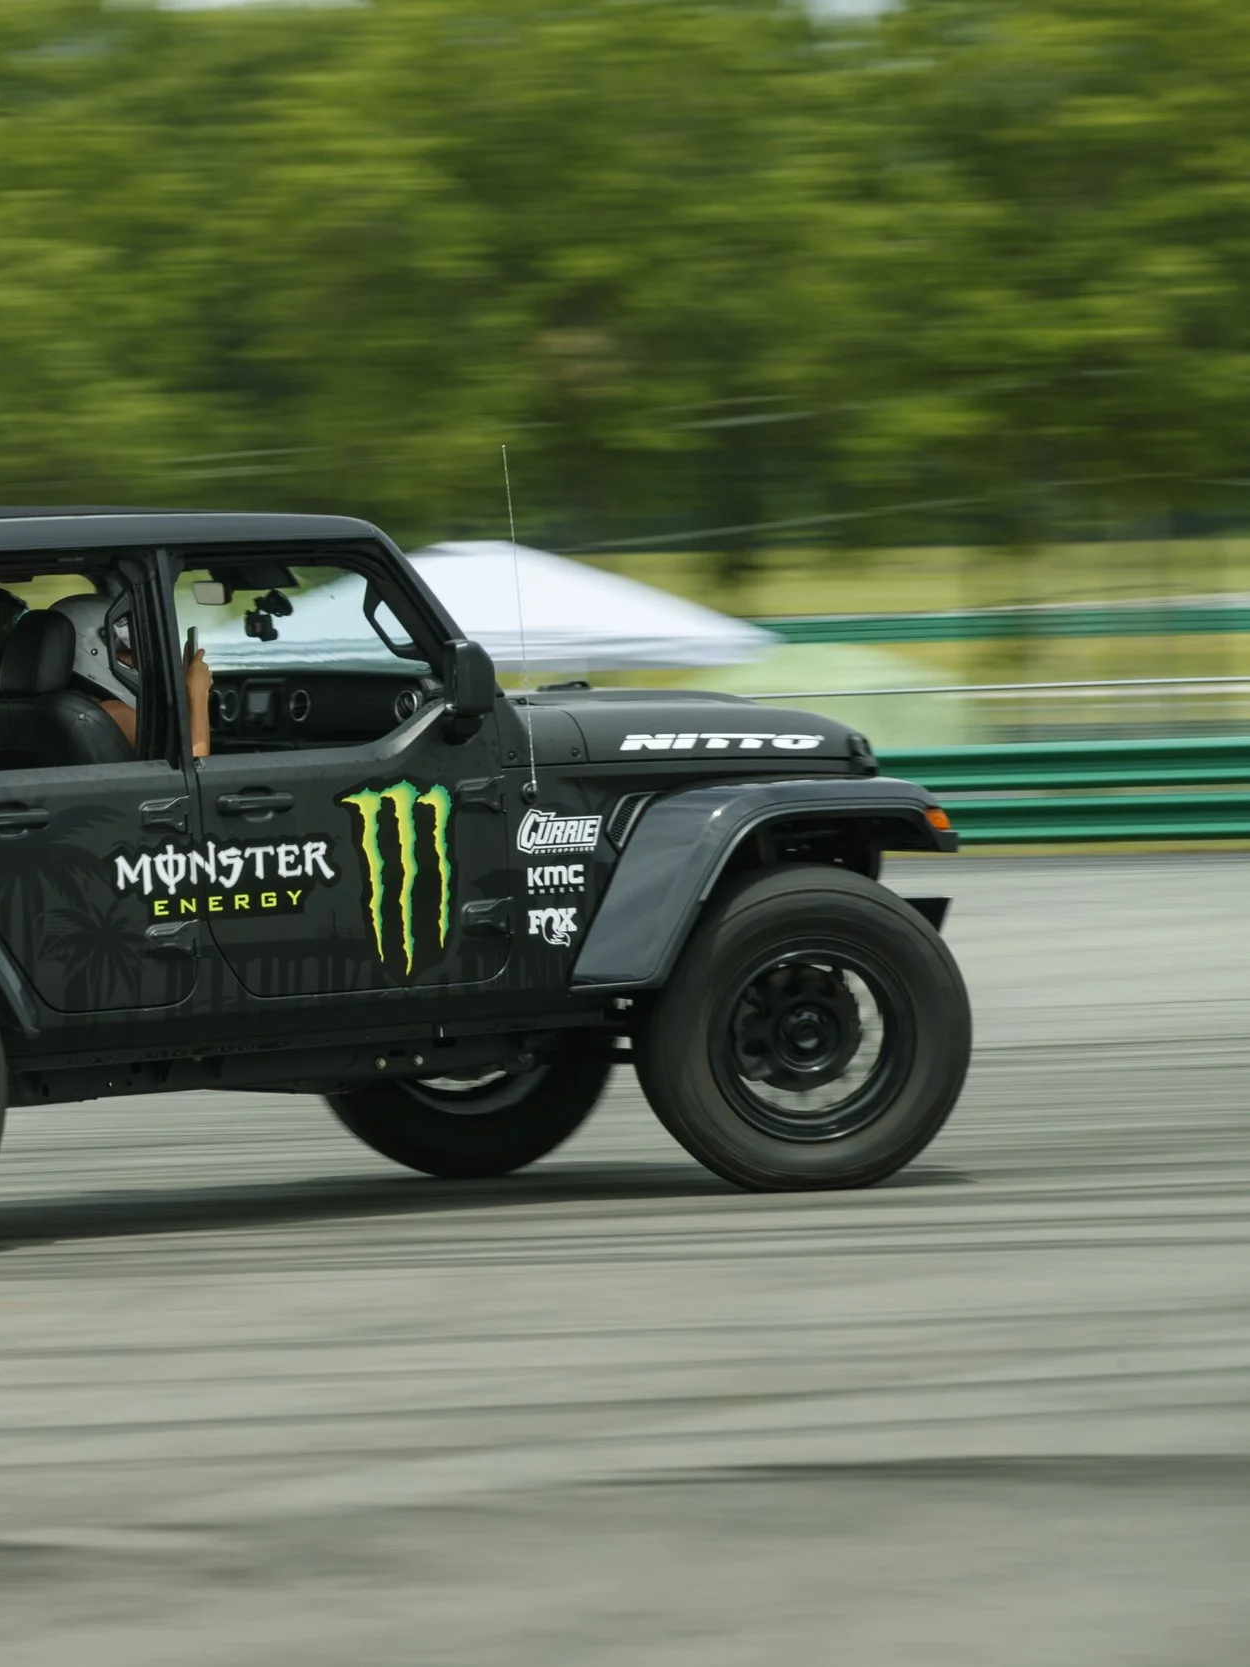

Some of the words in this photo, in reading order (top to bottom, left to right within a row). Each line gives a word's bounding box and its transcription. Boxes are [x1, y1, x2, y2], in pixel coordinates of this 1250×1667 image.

[619, 733, 821, 751] NITTO
[520, 812, 597, 850] CURRIE
[534, 846, 596, 855] ENTERPRISES
[114, 841, 335, 896] MONSTER
[527, 864, 585, 887] KMC
[528, 885, 585, 895] WHEELS
[154, 890, 302, 916] ENERGY
[528, 907, 578, 947] FOX
